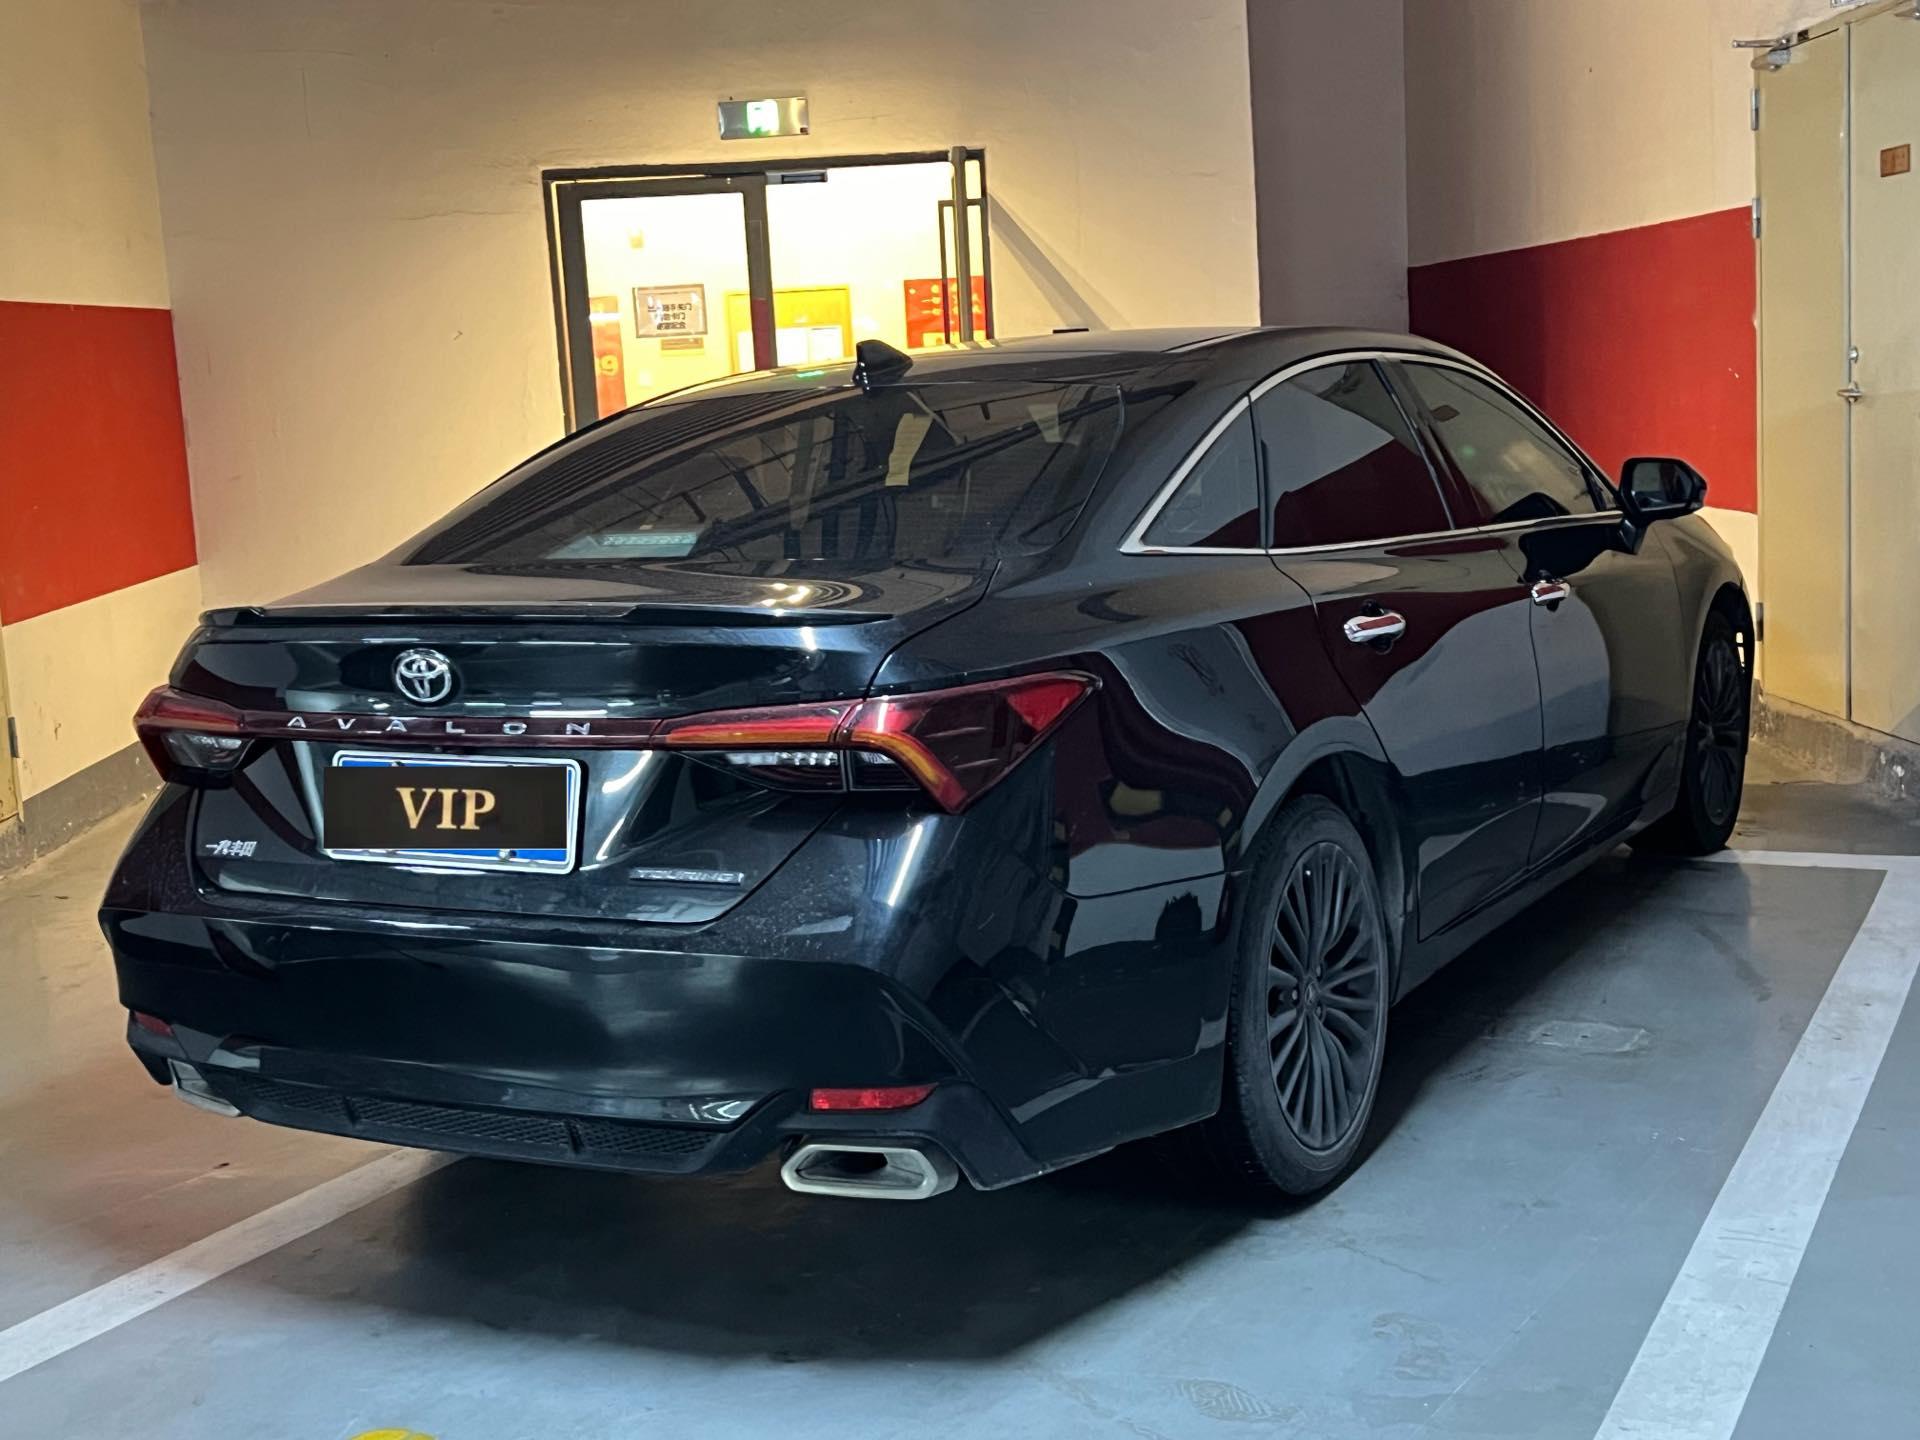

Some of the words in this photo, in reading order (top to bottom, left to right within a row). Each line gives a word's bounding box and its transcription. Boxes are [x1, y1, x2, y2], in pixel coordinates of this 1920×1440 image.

[287, 716, 591, 736] AVALON
[205, 839, 257, 857] 一汽丰田
